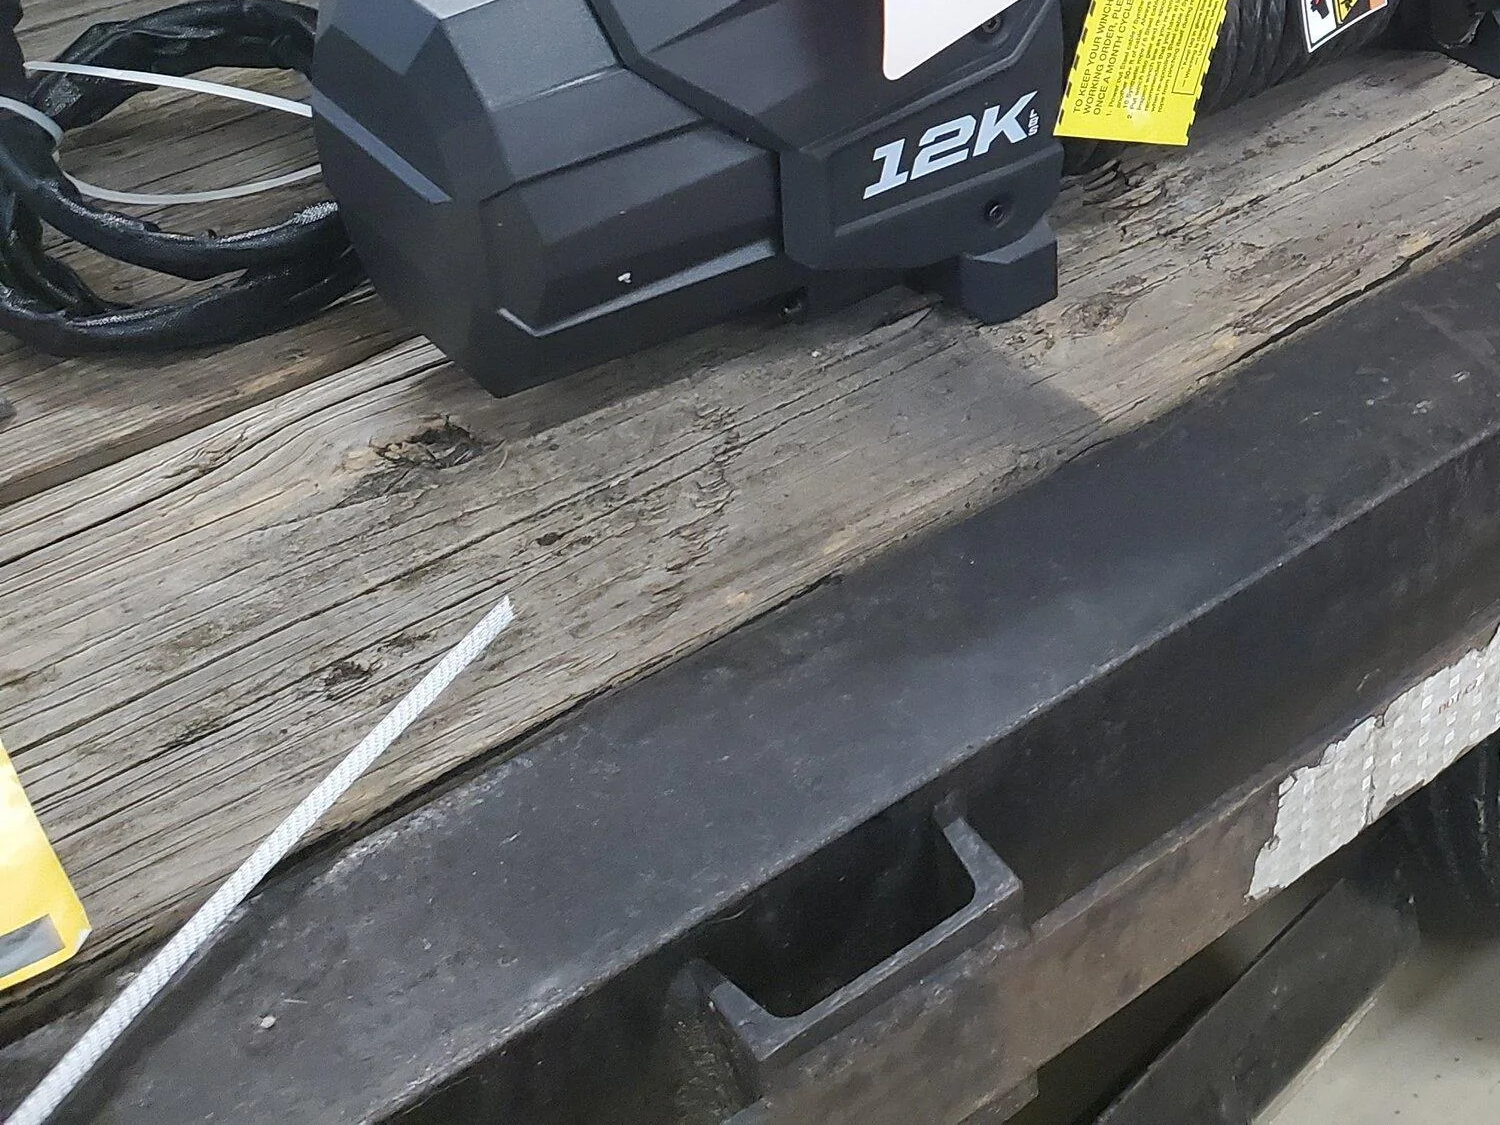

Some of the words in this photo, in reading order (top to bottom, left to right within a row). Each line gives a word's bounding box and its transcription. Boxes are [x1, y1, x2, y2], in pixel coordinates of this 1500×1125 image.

[1072, 98, 1083, 113] TO
[1078, 71, 1091, 95] KEEP
[1086, 36, 1101, 66] YOUR
[1083, 64, 1103, 114] WORKING
[1099, 22, 1117, 61] ORDER,
[1093, 86, 1108, 115] ONCE
[1105, 35, 1123, 73] MONTH
[1118, 0, 1134, 32] CYCLE
[1108, 85, 1119, 107] Power
[1119, 51, 1129, 69] Steel
[1126, 30, 1135, 50] cable
[1116, 81, 1127, 107] another
[1140, 1, 1151, 25] Always
[1125, 66, 1139, 97] Synthetic
[1136, 48, 1144, 63] rope
[1129, 97, 1137, 109] Put
[1134, 75, 1143, 95] winch
[1140, 59, 1148, 73] into
[1136, 84, 1148, 110] Inspect
[1145, 62, 1154, 83] winch
[1150, 48, 1158, 59] line
[1158, 24, 1166, 36] you
[1144, 61, 1161, 110] recommended
[1157, 45, 1166, 59] that
[1166, 13, 1176, 30] have
[1150, 93, 1159, 111] when
[1156, 52, 1171, 91] re-spooling
[1167, 33, 1176, 50] Steel
[1174, 13, 1183, 31] cable
[1157, 96, 1165, 112] rope
[1161, 79, 1169, 94] from
[1167, 48, 1180, 77] pinching
[1176, 30, 1184, 46] itself
[1182, 6, 1193, 28] during
[863, 90, 1038, 200] 12K
[1028, 109, 1040, 137] LBS
